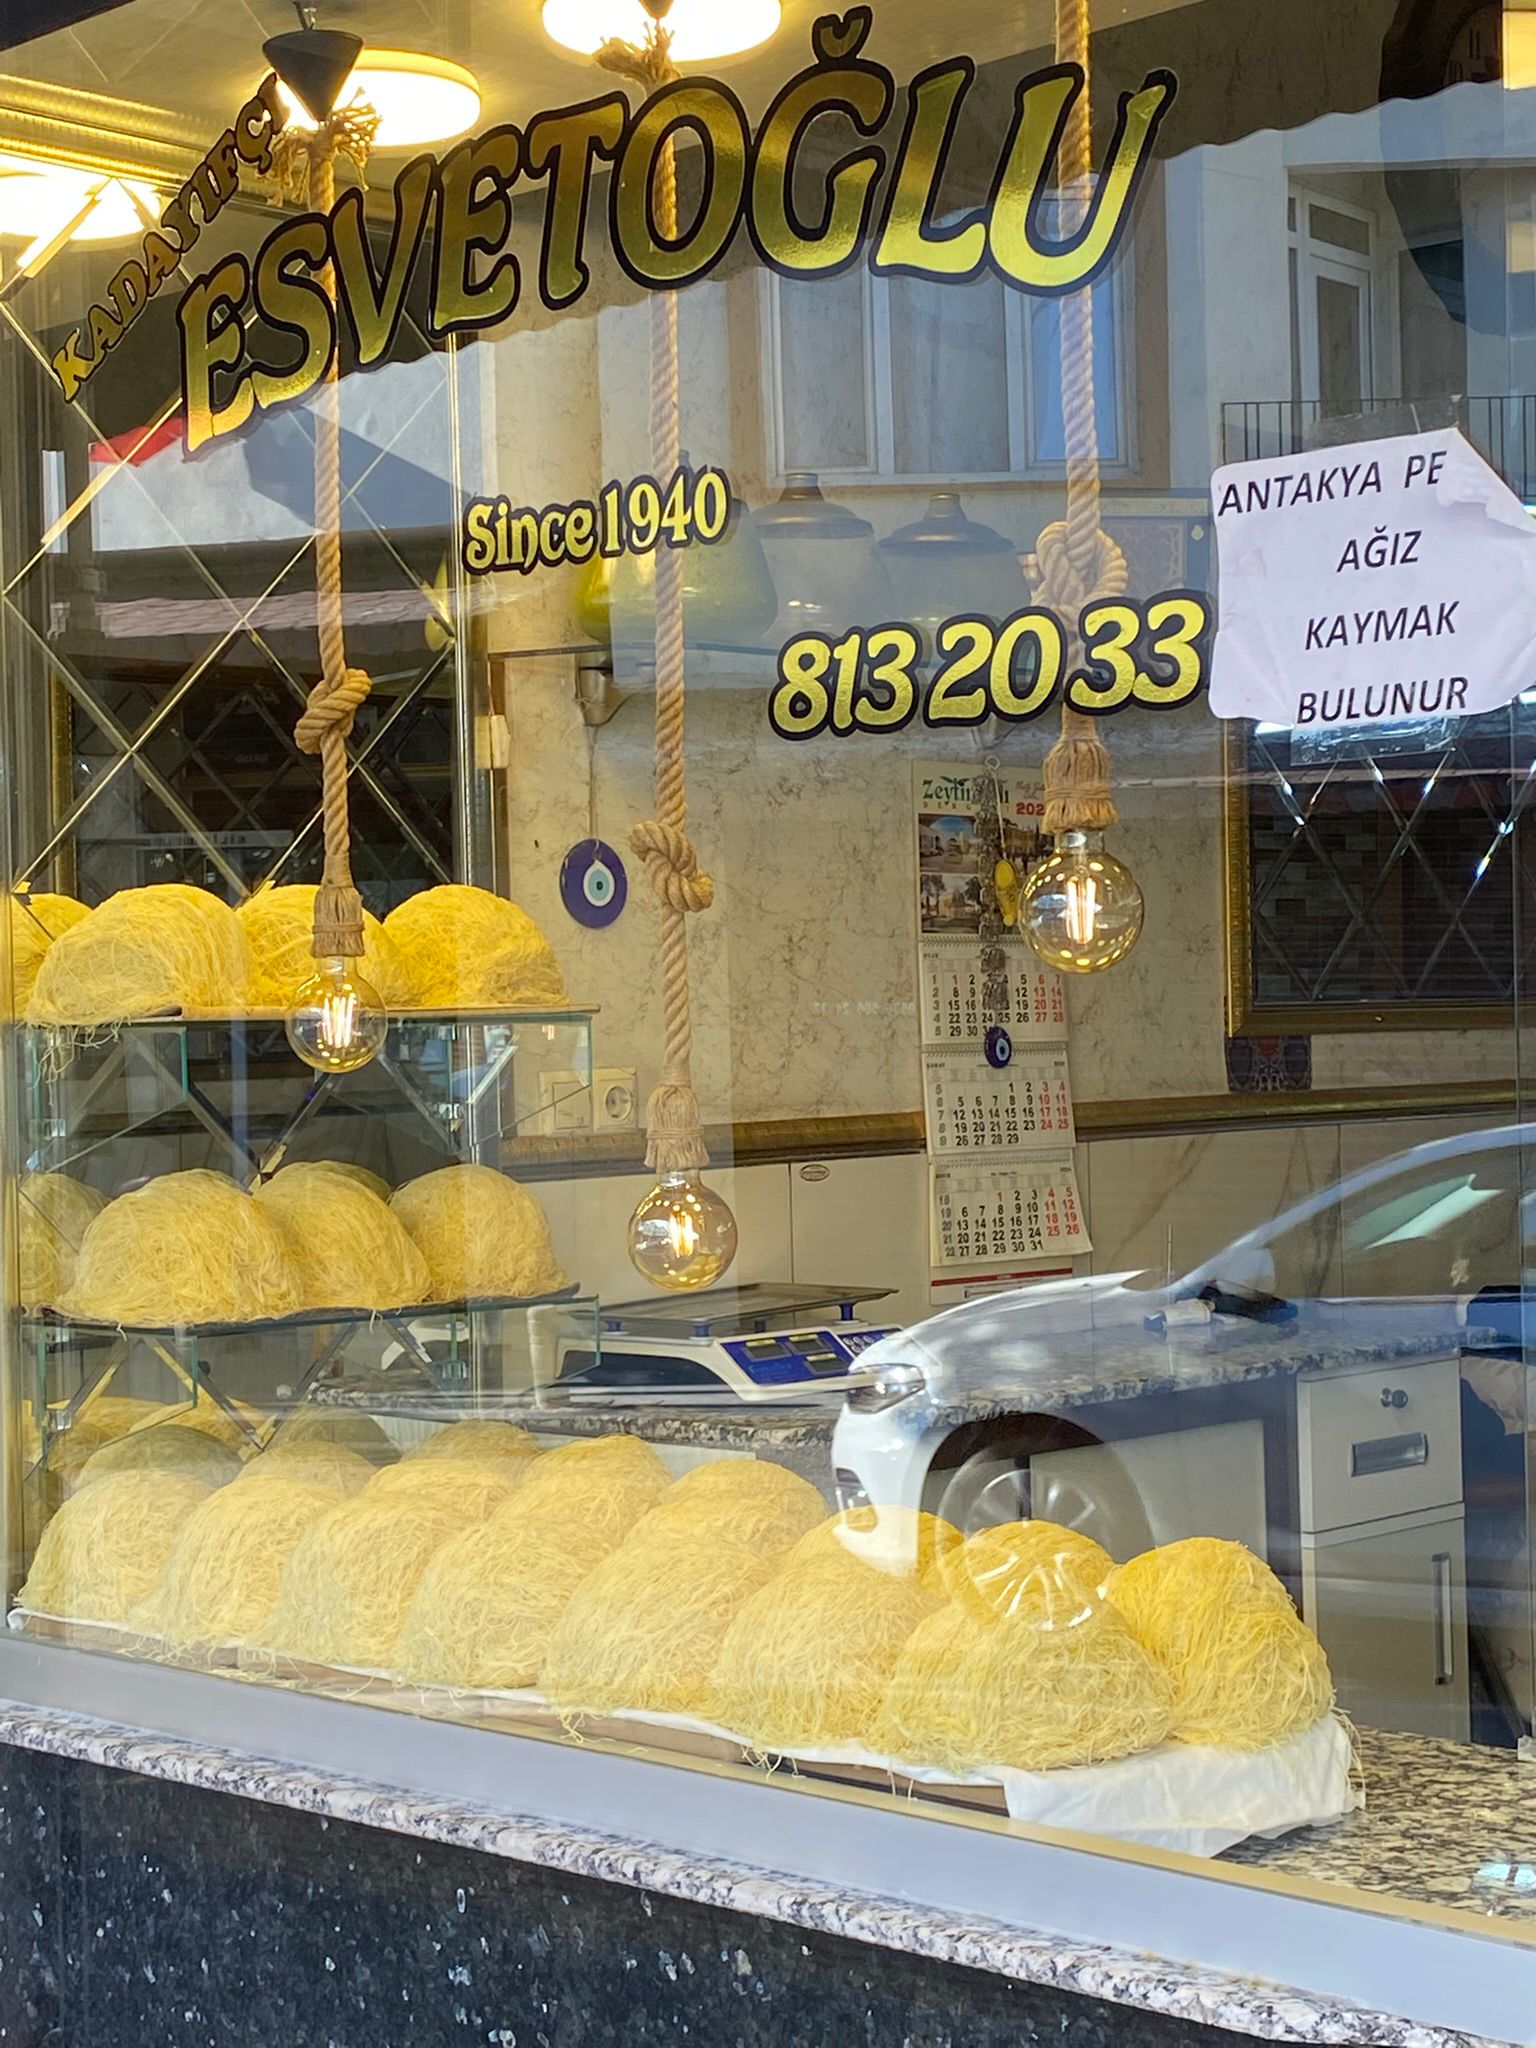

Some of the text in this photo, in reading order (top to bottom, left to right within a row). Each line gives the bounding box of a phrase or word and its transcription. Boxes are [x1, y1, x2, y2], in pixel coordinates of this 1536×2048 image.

[178, 5, 1178, 460] ESVETOĞLU
[1218, 461, 1382, 516] ANTAKYA
[1337, 526, 1423, 572] AĞIZ
[1305, 601, 1460, 650] KAYMAK
[769, 589, 1209, 740] 813 20 33
[1297, 677, 1468, 724] BULUNUR
[1016, 802, 1046, 815] 202
[952, 975, 958, 985] 1
[969, 974, 975, 985] 2
[1020, 974, 1027, 985] 5
[1038, 975, 1045, 985] 6
[1055, 974, 1061, 984] 7
[953, 988, 959, 998] 8
[969, 987, 976, 998] 9
[1015, 988, 1028, 998] 12
[1034, 988, 1046, 997] 13
[1051, 987, 1062, 997] 14
[948, 1000, 960, 1011] 15
[965, 1000, 977, 1011] 16
[1016, 1000, 1028, 1010] 19
[1034, 1000, 1047, 1010] 20
[1051, 1000, 1063, 1010] 21
[949, 1014, 961, 1024] 22
[966, 1013, 977, 1024] 23
[982, 1013, 993, 1023] 24
[998, 1013, 1010, 1023] 25
[1016, 1013, 1029, 1023] 26
[1035, 1013, 1047, 1023] 27
[1053, 1012, 1064, 1022] 28
[949, 1026, 962, 1036] 29
[967, 1026, 978, 1036] 30
[1009, 1082, 1014, 1092] 1
[1025, 1082, 1032, 1092] 2
[1042, 1081, 1049, 1092] 3
[1059, 1081, 1065, 1090] 4
[958, 1096, 964, 1107] 5
[975, 1096, 982, 1106] 6
[992, 1095, 998, 1106] 7
[1009, 1095, 1015, 1105] 8
[1026, 1095, 1033, 1105] 9
[1039, 1094, 1050, 1105] 10
[1056, 1094, 1066, 1104] 11
[953, 1110, 966, 1120] 12
[971, 1109, 984, 1119] 13
[989, 1109, 1000, 1119] 14
[1005, 1108, 1016, 1119] 15
[1023, 1108, 1034, 1118] 16
[1040, 1107, 1051, 1117] 17
[1056, 1107, 1068, 1116] 18
[954, 1122, 967, 1133] 19
[972, 1122, 985, 1132] 20
[990, 1121, 1001, 1131] 21
[1006, 1121, 1018, 1131] 22
[1023, 1120, 1036, 1130] 23
[1040, 1120, 1052, 1129] 24
[1058, 1119, 1069, 1129] 25
[955, 1135, 969, 1146] 26
[974, 1134, 986, 1145] 27
[991, 1134, 1003, 1144] 28
[1007, 1133, 1019, 1144] 29
[998, 1192, 1002, 1202] 1
[1014, 1190, 1021, 1201] 2
[1032, 1189, 1038, 1200] 3
[1048, 1188, 1055, 1198] 4
[1066, 1187, 1072, 1197] 5
[961, 1207, 968, 1217] 6
[979, 1206, 985, 1216] 7
[997, 1204, 1004, 1215] 8
[1014, 1203, 1021, 1214] 9
[1027, 1202, 1038, 1213] 10
[1045, 1201, 1056, 1211] 11
[1063, 1200, 1075, 1210] 12
[957, 1220, 969, 1231] 13
[974, 1219, 987, 1229] 14
[992, 1217, 1004, 1228] 15
[1010, 1216, 1022, 1227] 16
[1028, 1215, 1039, 1225] 17
[1045, 1214, 1058, 1224] 18
[1064, 1212, 1077, 1222] 19
[957, 1233, 969, 1244] 20
[974, 1232, 986, 1242] 21
[992, 1230, 1005, 1241] 22
[1010, 1229, 1023, 1240] 23
[1028, 1227, 1041, 1238] 24
[1046, 1226, 1060, 1237] 25
[1066, 1224, 1080, 1235] 26
[959, 1246, 970, 1257] 27
[975, 1245, 988, 1255] 28
[993, 1243, 1006, 1254] 29
[1012, 1242, 1025, 1252] 30
[1030, 1240, 1044, 1251] 31
